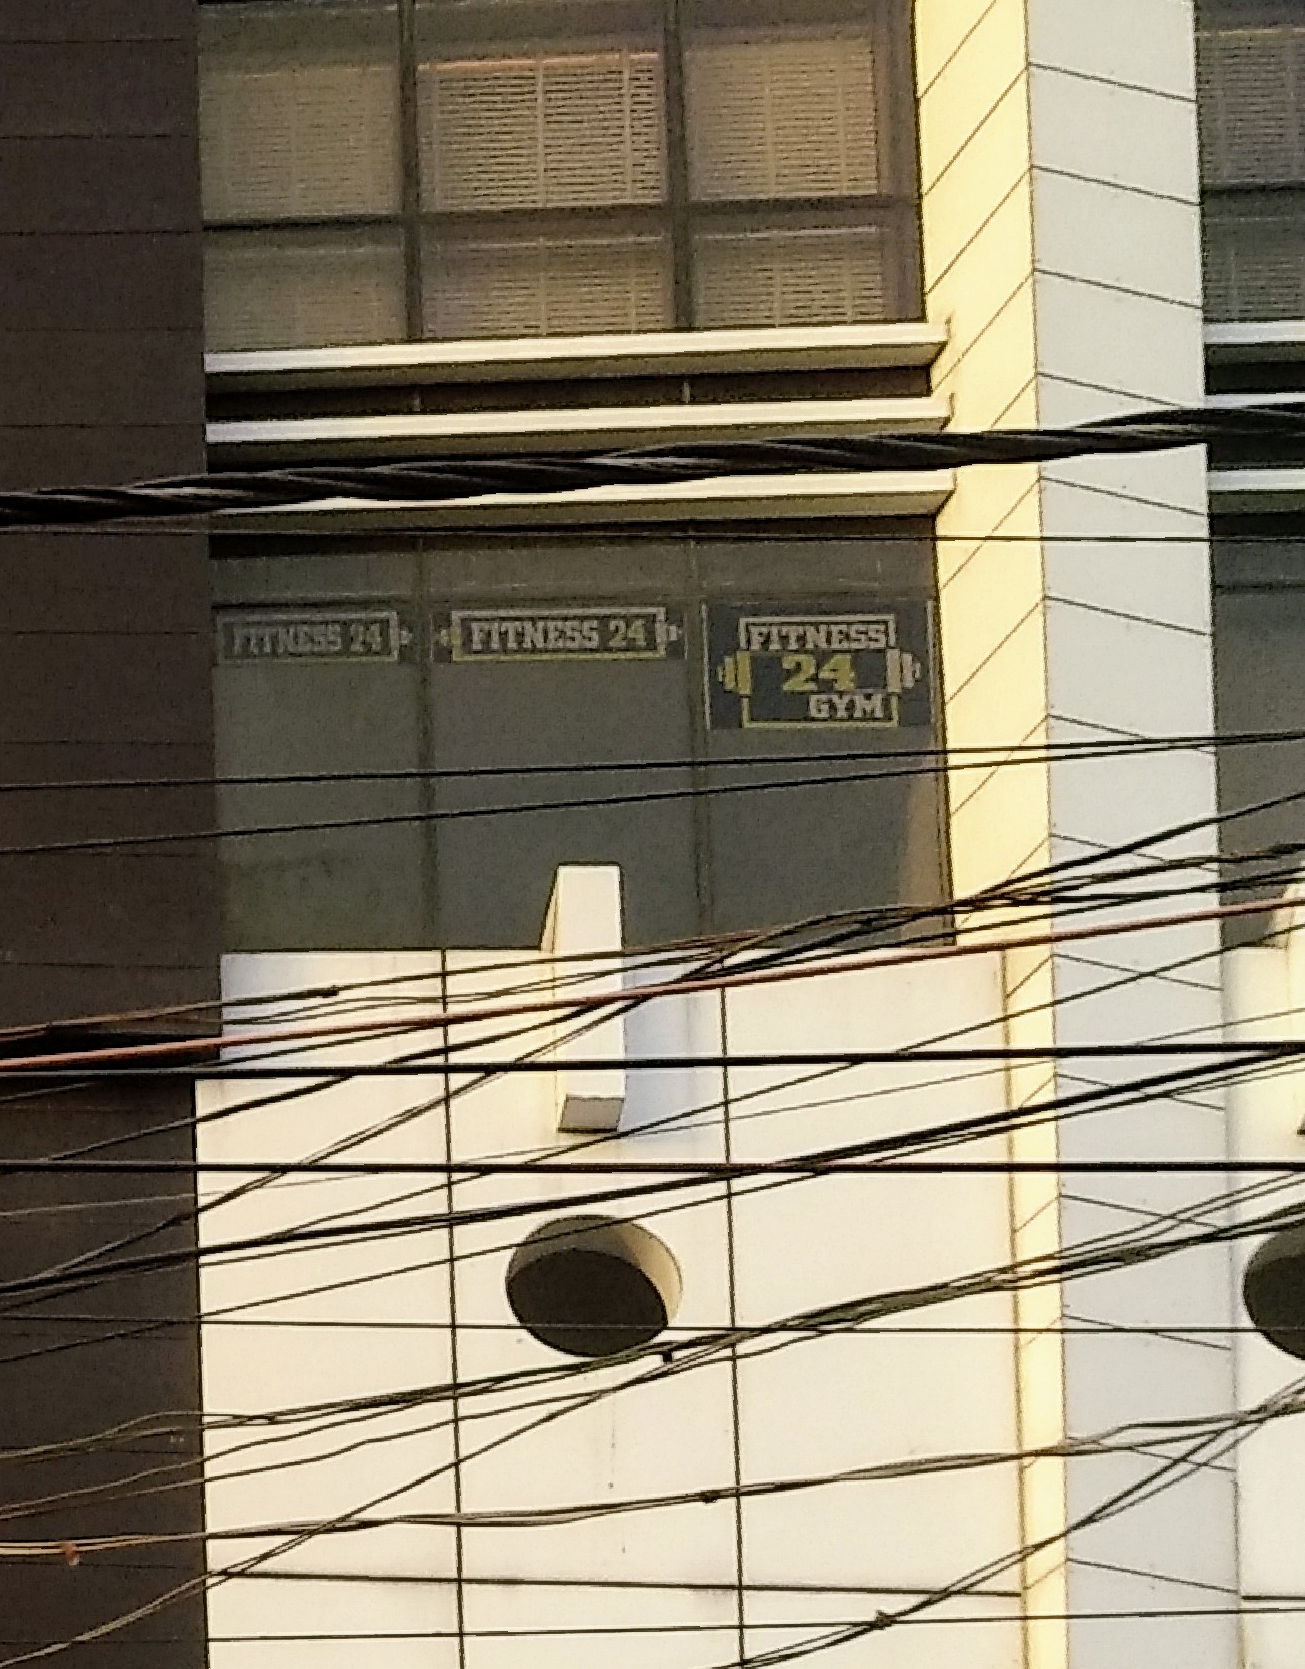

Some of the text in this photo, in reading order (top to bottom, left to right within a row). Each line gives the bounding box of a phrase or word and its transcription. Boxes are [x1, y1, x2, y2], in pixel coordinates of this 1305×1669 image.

[232, 622, 382, 655] FITNESS 24
[469, 618, 649, 651] FITNESS 24
[747, 623, 887, 650] FITNESS
[780, 652, 858, 691] 24
[808, 693, 885, 719] GYM
